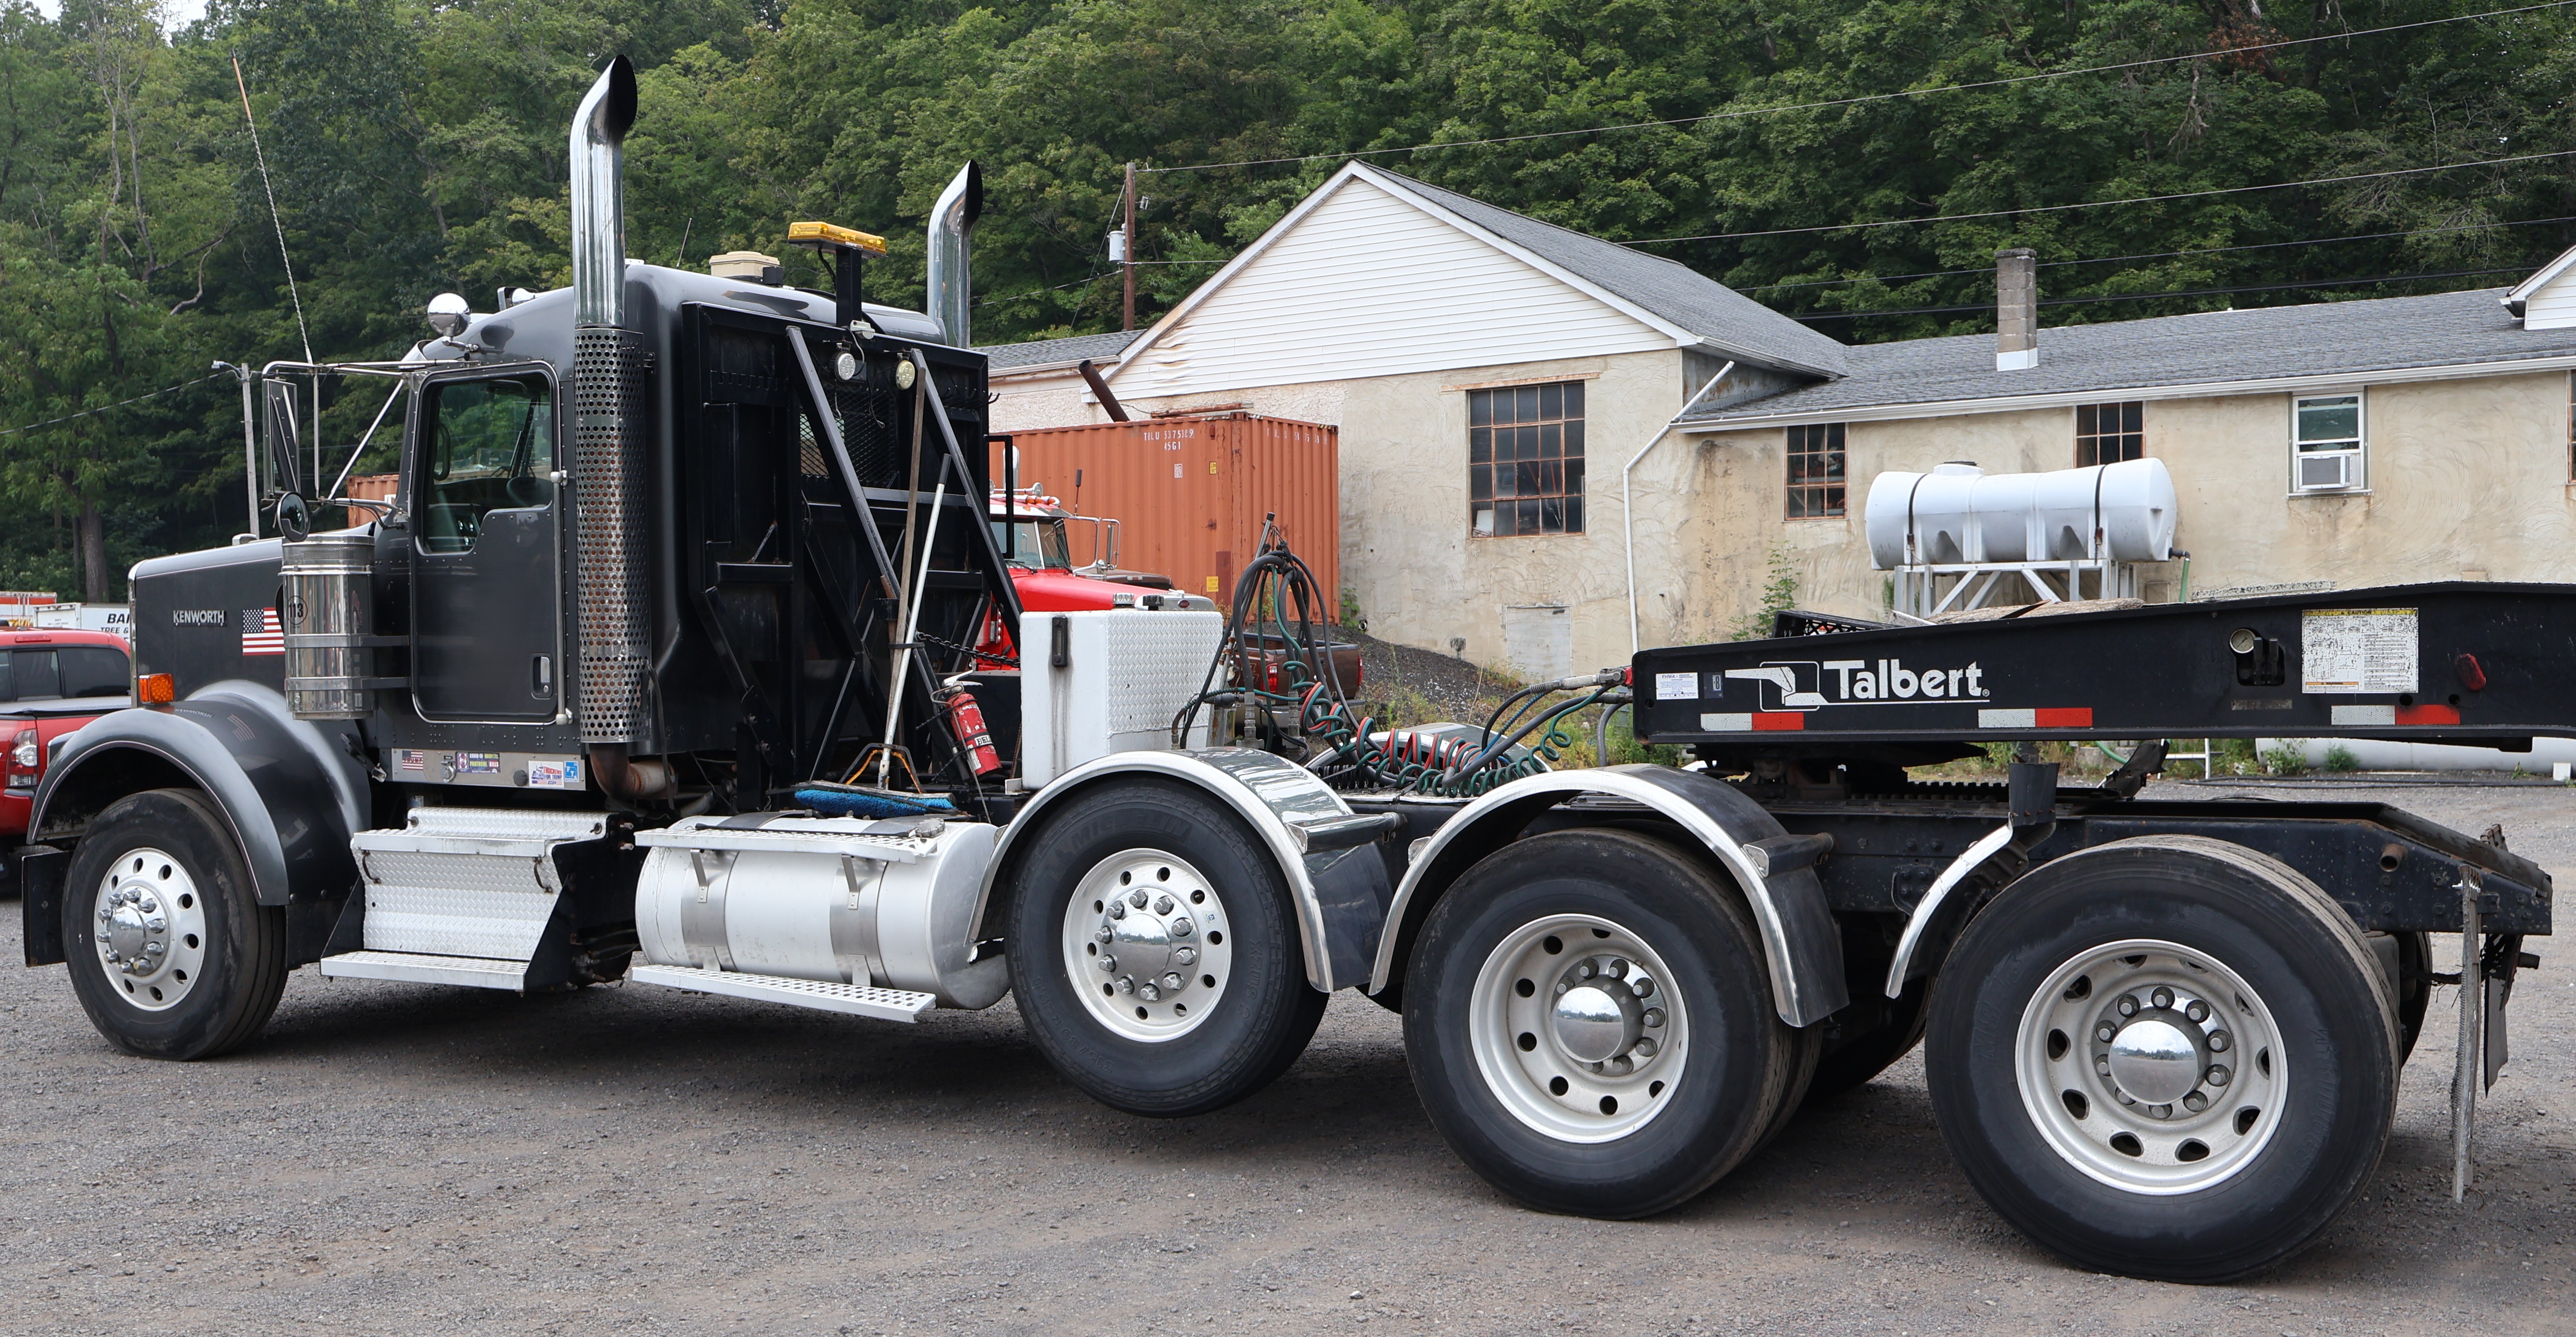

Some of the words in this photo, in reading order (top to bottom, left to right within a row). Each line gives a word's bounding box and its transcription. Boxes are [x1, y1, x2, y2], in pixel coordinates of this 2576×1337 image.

[1164, 441, 1181, 451] 45G1
[173, 610, 225, 623] KENWORTH
[289, 603, 303, 618] 113
[1823, 659, 1982, 699] Talbert
[1071, 809, 1190, 849] MICHELIN
